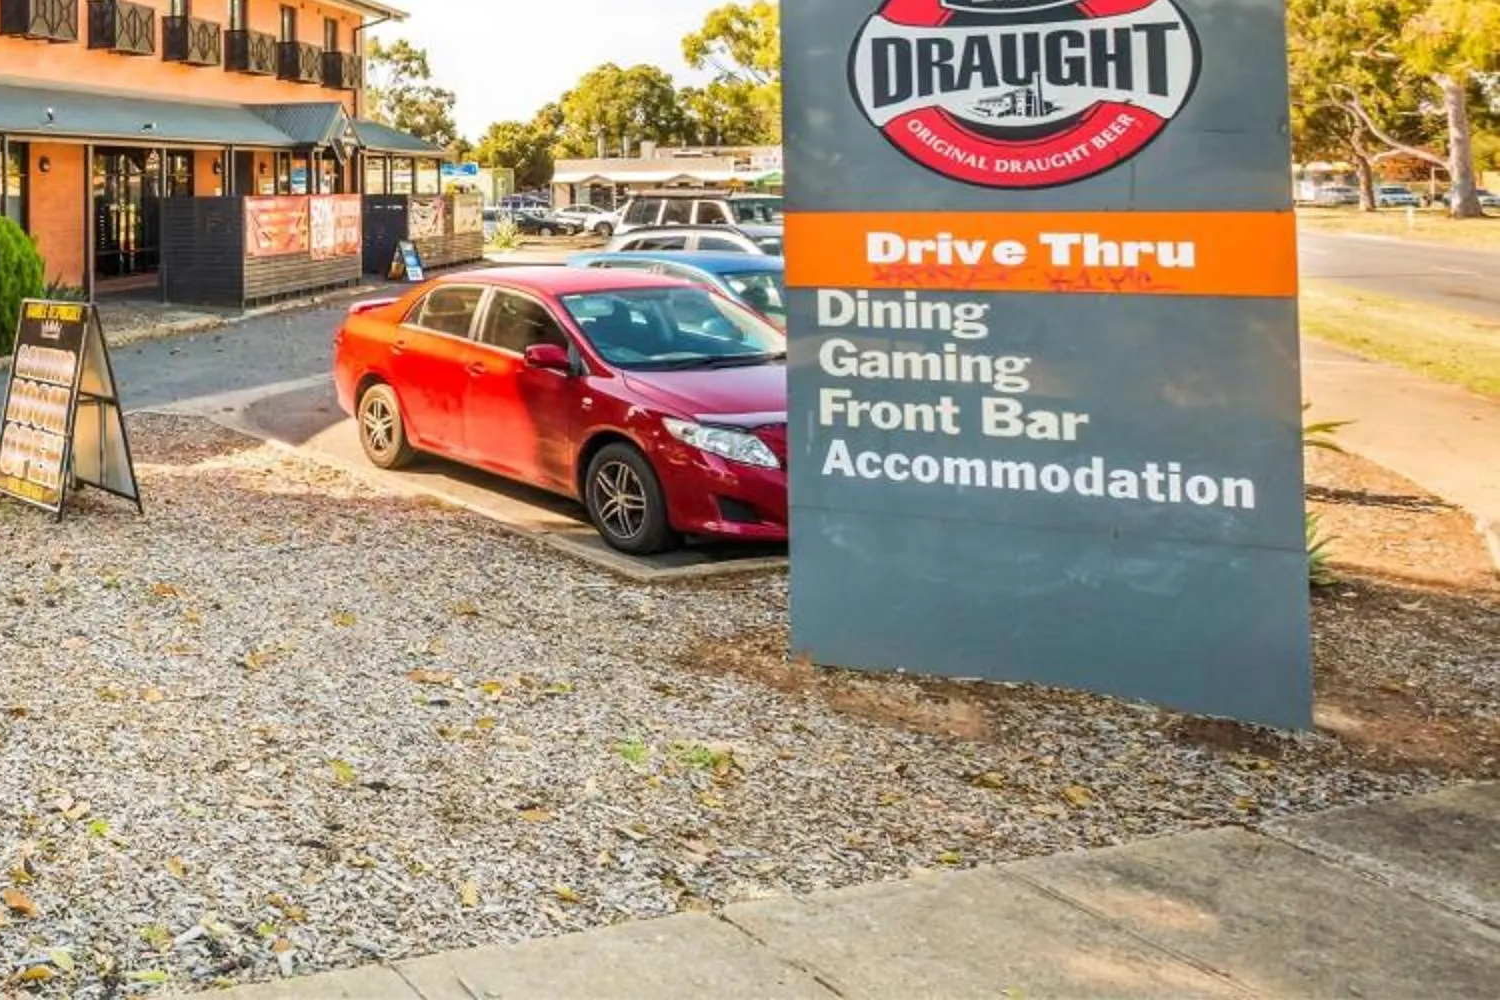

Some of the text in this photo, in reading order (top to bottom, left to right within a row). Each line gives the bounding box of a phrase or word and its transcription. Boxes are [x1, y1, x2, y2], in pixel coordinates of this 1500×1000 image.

[871, 21, 1180, 108] DRAUGHT
[907, 113, 1136, 173] ORIGINAL DRAUGHT BEER
[866, 231, 1195, 268] Drive Thru
[817, 289, 990, 339] Dining
[818, 339, 1032, 392] Gaming
[819, 388, 1089, 441] Front Bar
[821, 439, 1256, 509] Accommodation
